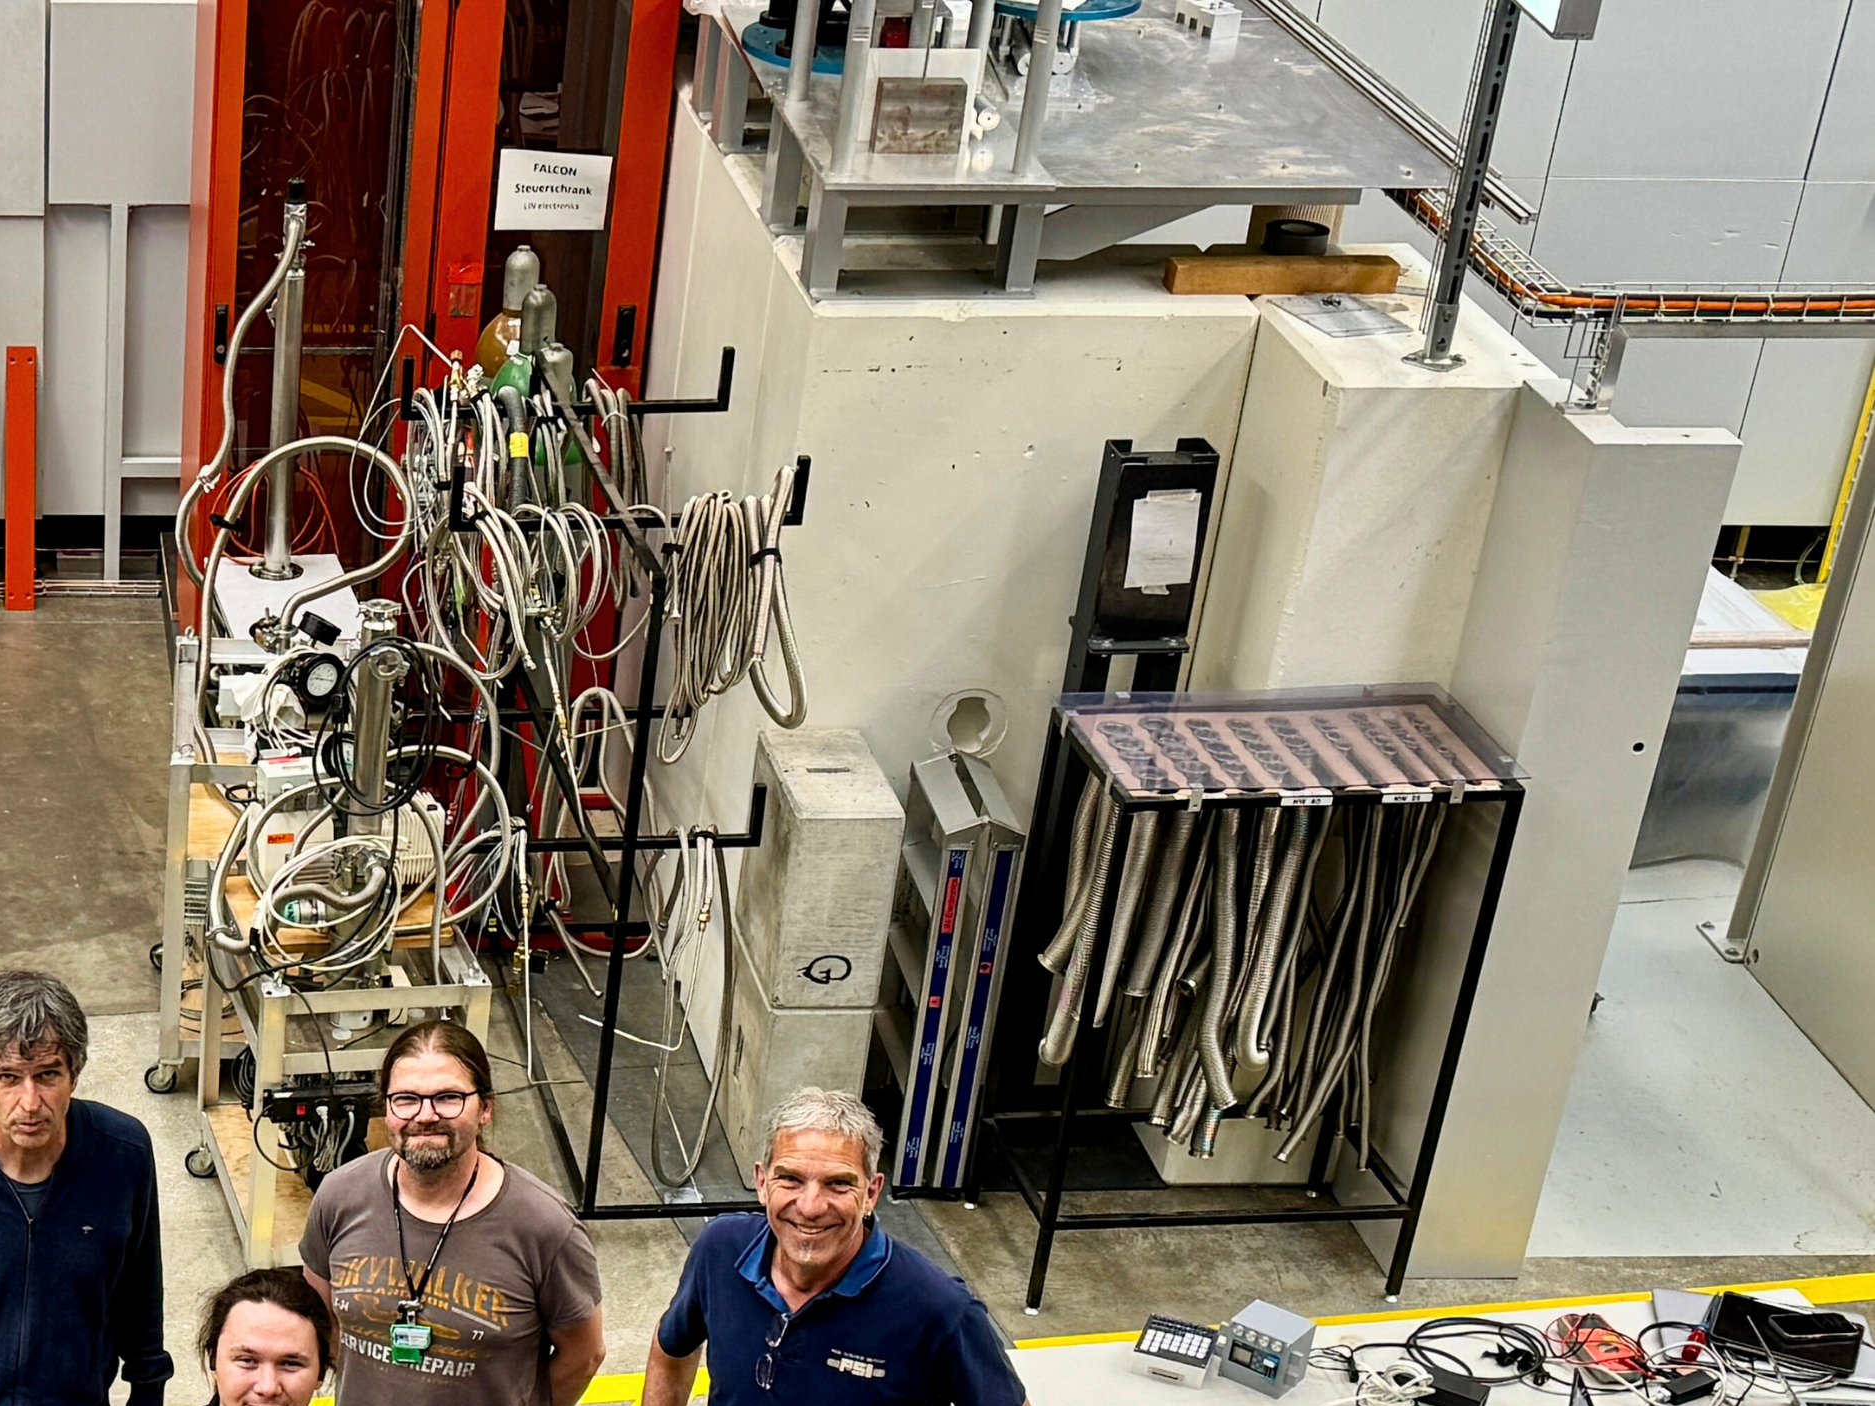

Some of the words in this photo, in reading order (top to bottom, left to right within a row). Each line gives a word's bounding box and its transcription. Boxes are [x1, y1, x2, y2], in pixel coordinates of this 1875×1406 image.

[534, 163, 577, 176] FALCON
[515, 183, 592, 195] Steuerschrank
[472, 1329, 484, 1341] 77
[839, 1358, 874, 1378] PSI
